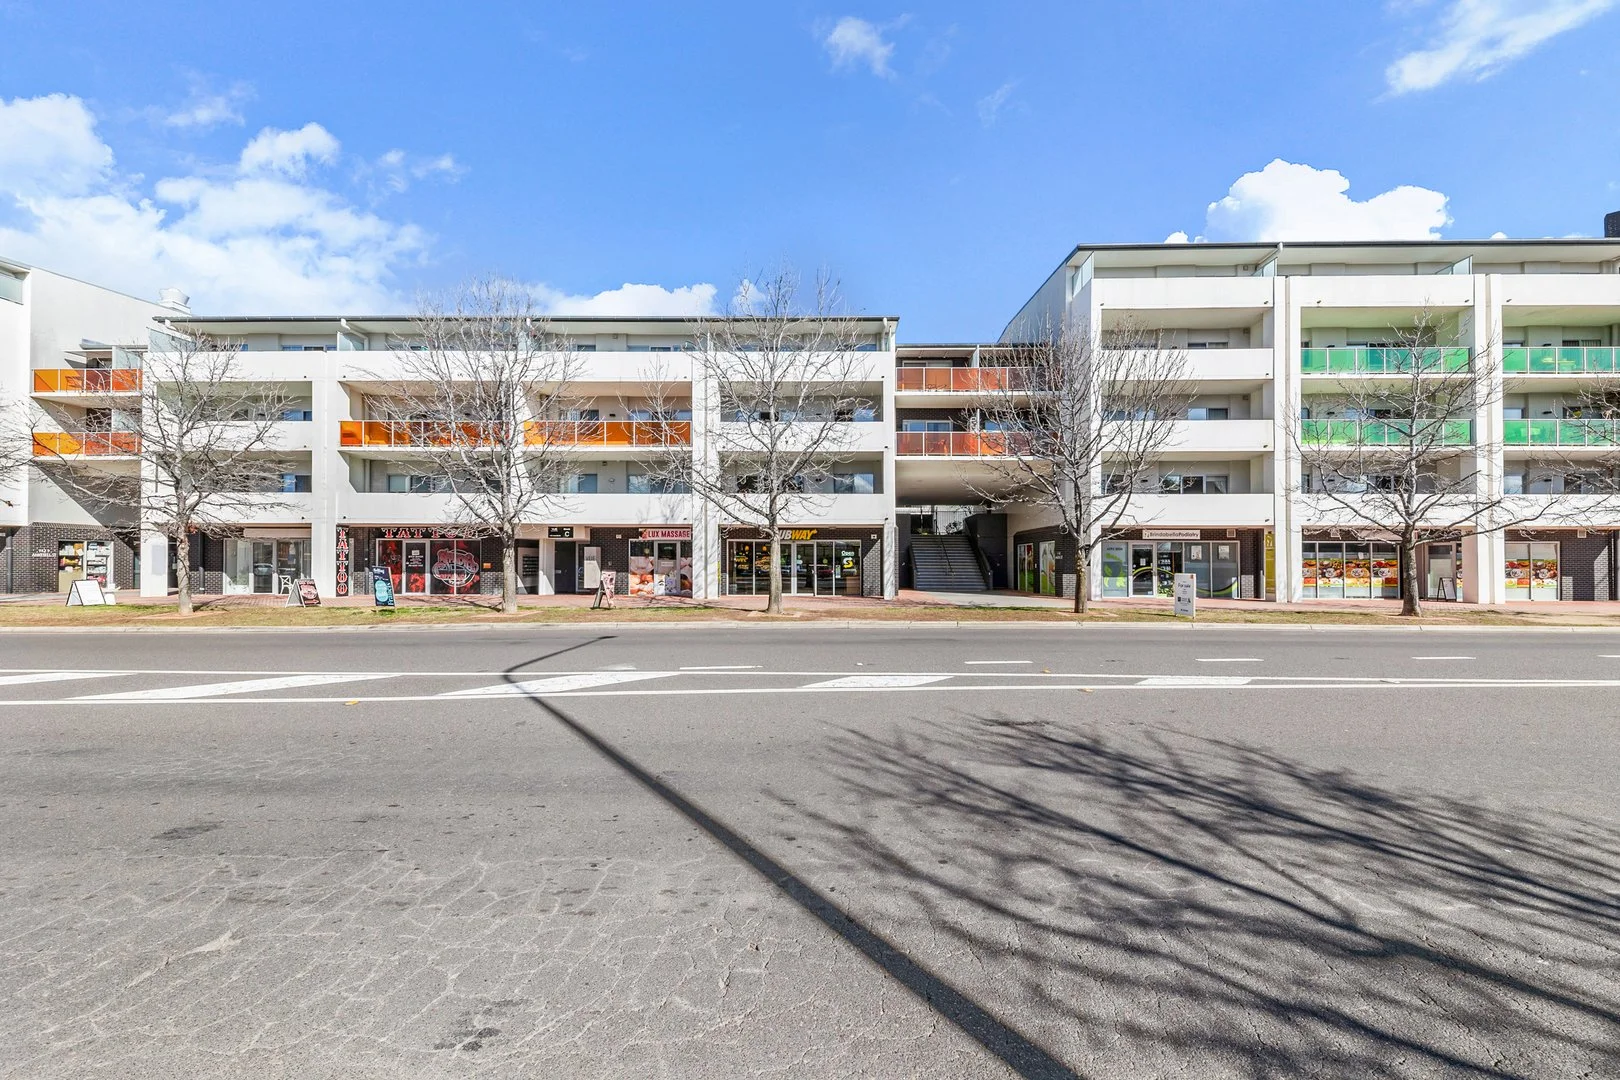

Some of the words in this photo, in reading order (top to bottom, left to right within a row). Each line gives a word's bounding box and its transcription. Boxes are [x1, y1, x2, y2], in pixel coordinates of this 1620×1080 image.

[648, 530, 660, 538] LUX
[661, 530, 690, 538] MASSAGE
[776, 529, 817, 540] UBWAY
[336, 527, 349, 594] TATTOO
